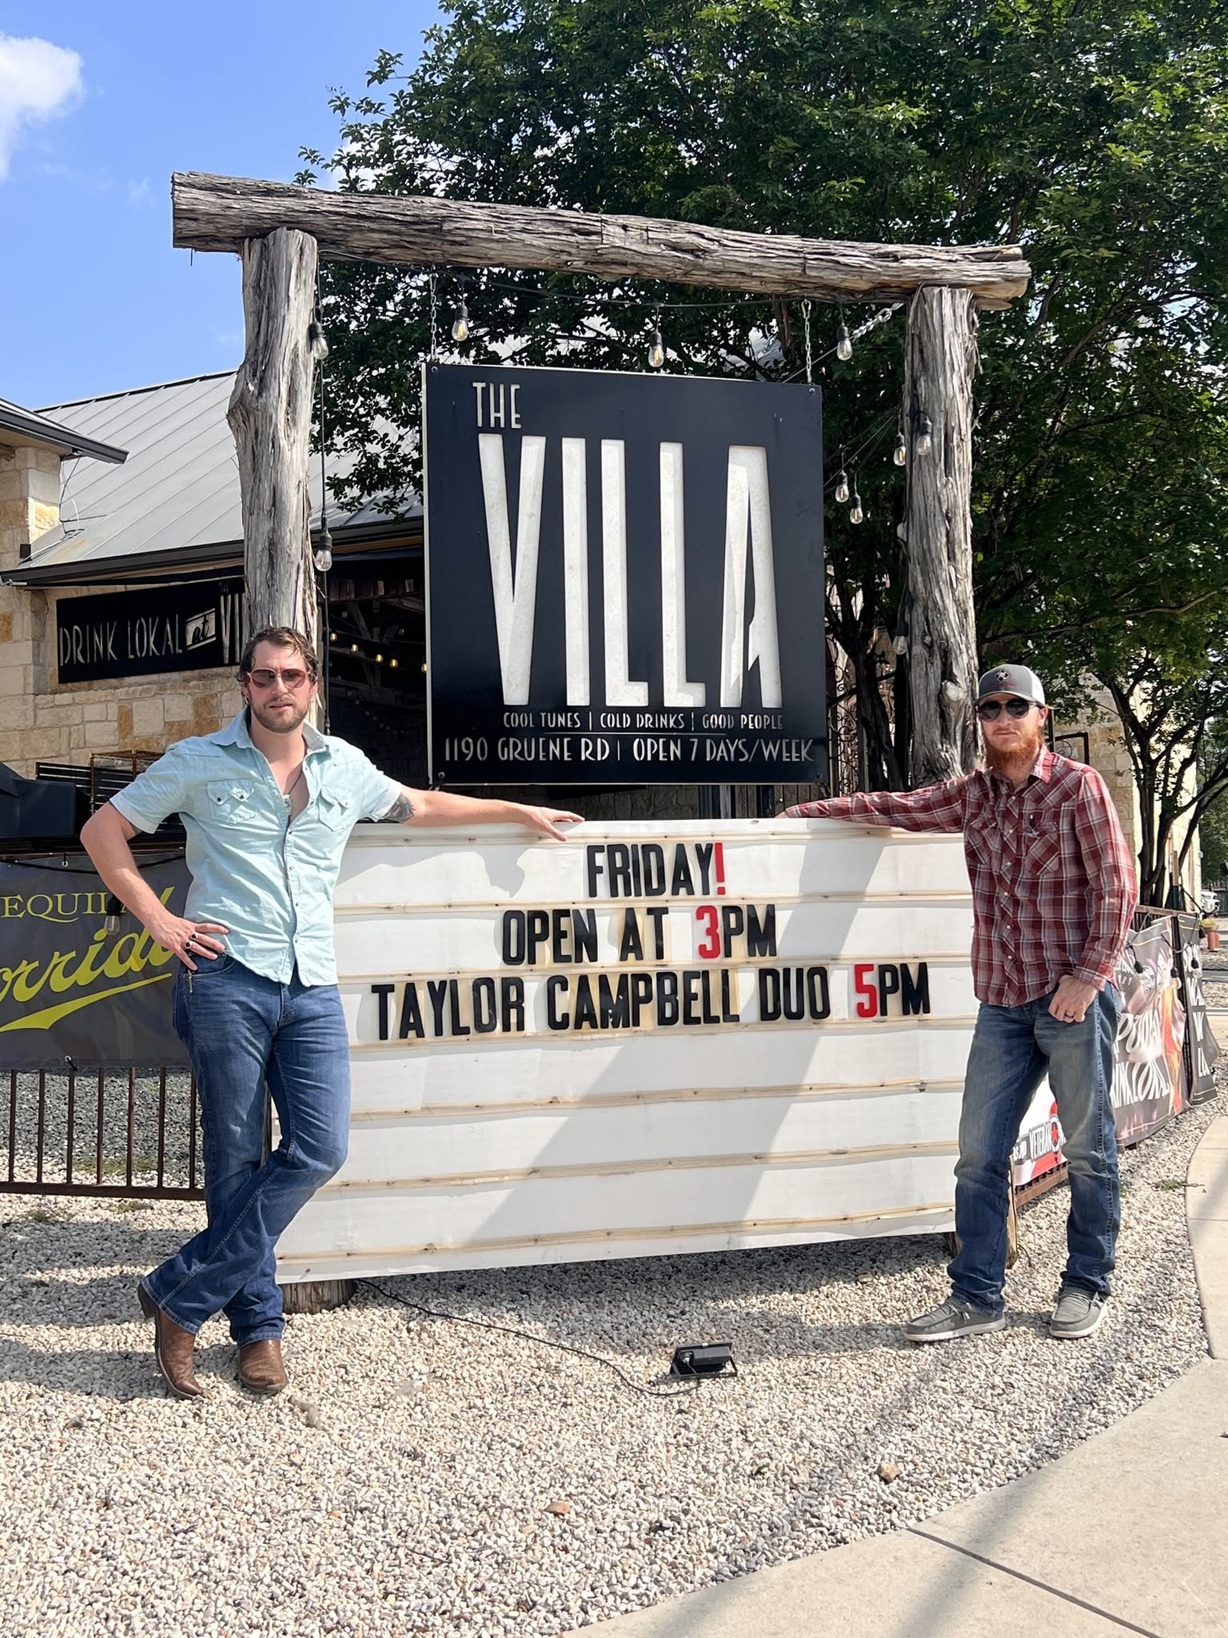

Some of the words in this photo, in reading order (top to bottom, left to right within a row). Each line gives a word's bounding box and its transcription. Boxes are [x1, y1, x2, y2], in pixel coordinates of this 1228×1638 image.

[472, 382, 522, 429] THE
[478, 433, 783, 708] VILLA
[59, 621, 117, 666] DRINK
[127, 614, 183, 659] LOKAL
[503, 712, 535, 730] COOL
[540, 713, 581, 728] TUNES
[600, 713, 631, 730] COLD
[636, 713, 685, 730] DRINKS
[702, 715, 735, 731] GOOD
[740, 714, 783, 731] PEOPLE
[445, 737, 488, 762] 1190
[497, 737, 573, 762] GRUENE
[580, 737, 611, 762] RD
[632, 738, 682, 762] OPEN
[689, 738, 699, 762] 7
[706, 738, 814, 764] DAYS/WEEK
[586, 842, 726, 898] FRIDAY!
[502, 908, 598, 966] OPEN
[619, 907, 669, 961] AT
[696, 903, 777, 959] 3PM
[371, 977, 525, 1040] TAYLOR
[546, 968, 740, 1031] CAMPBELL
[759, 966, 831, 1021] DUO
[854, 962, 931, 1018] 5PM
